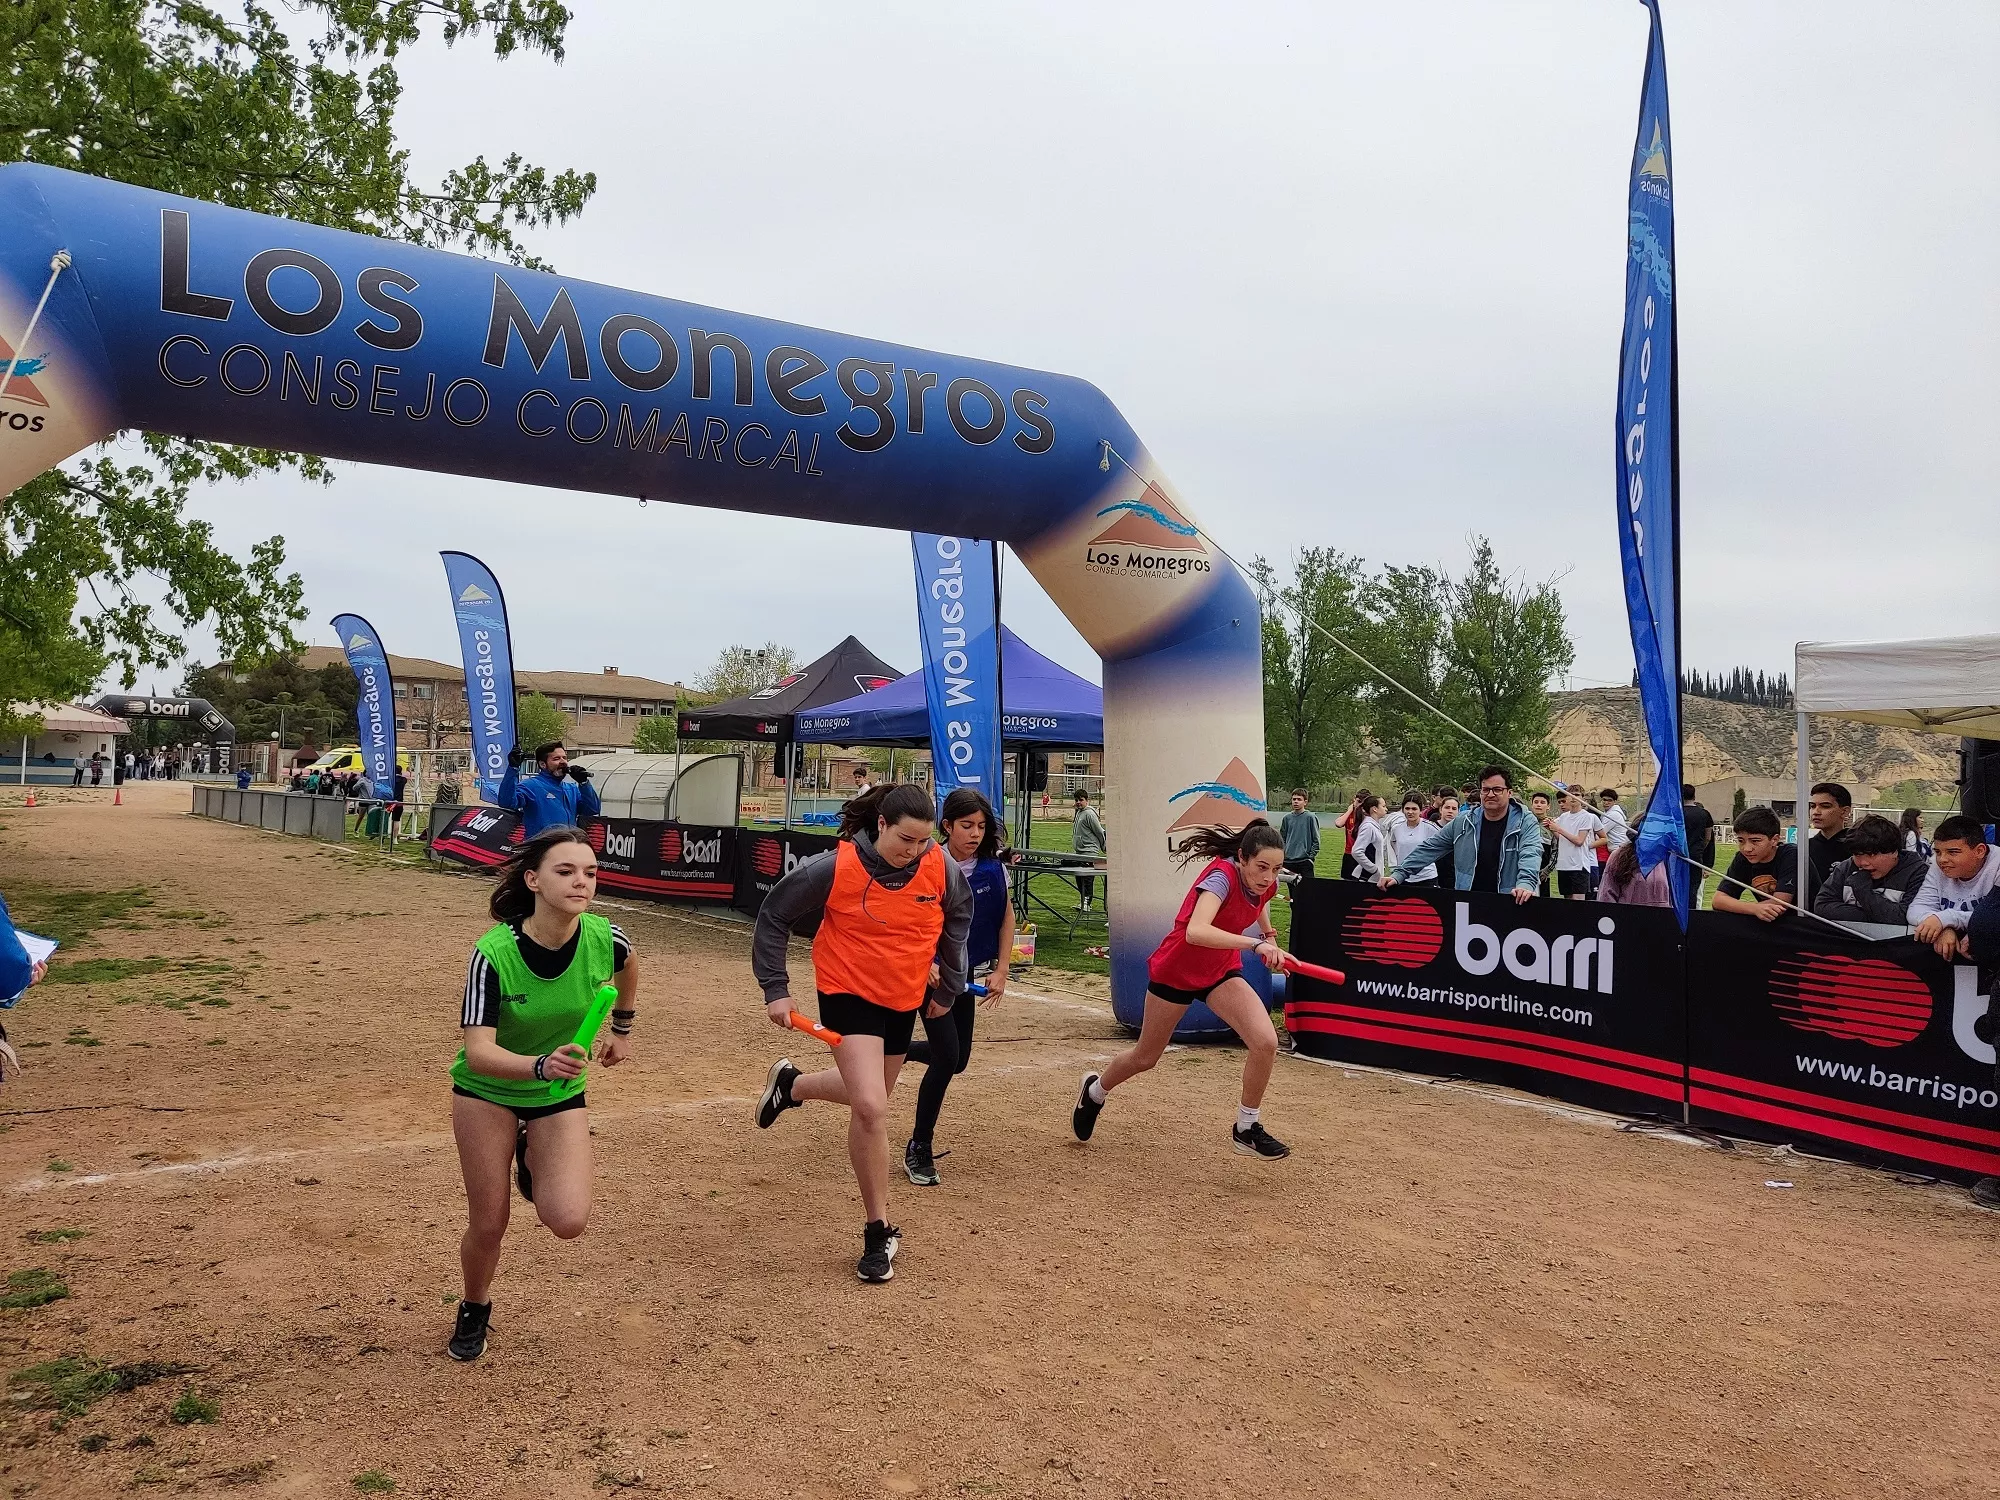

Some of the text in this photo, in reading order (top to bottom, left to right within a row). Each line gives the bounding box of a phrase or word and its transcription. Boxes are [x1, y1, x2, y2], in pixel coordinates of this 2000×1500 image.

[160, 208, 1055, 455] Los Monegros
[158, 334, 824, 477] CONSEJO COMARCAL
[1085, 563, 1177, 580] CONSEJO COMARCAL
[1086, 547, 1211, 575] Los Monegros
[149, 699, 190, 716] barri
[764, 722, 779, 734] barri
[800, 715, 850, 731] Los Monegros
[1002, 714, 1058, 730] onegros
[466, 809, 504, 833] barri
[606, 824, 636, 859] barri
[682, 829, 721, 864] barri
[1454, 901, 1616, 995] barri
[1356, 979, 1593, 1027] www.barrisportline.com
